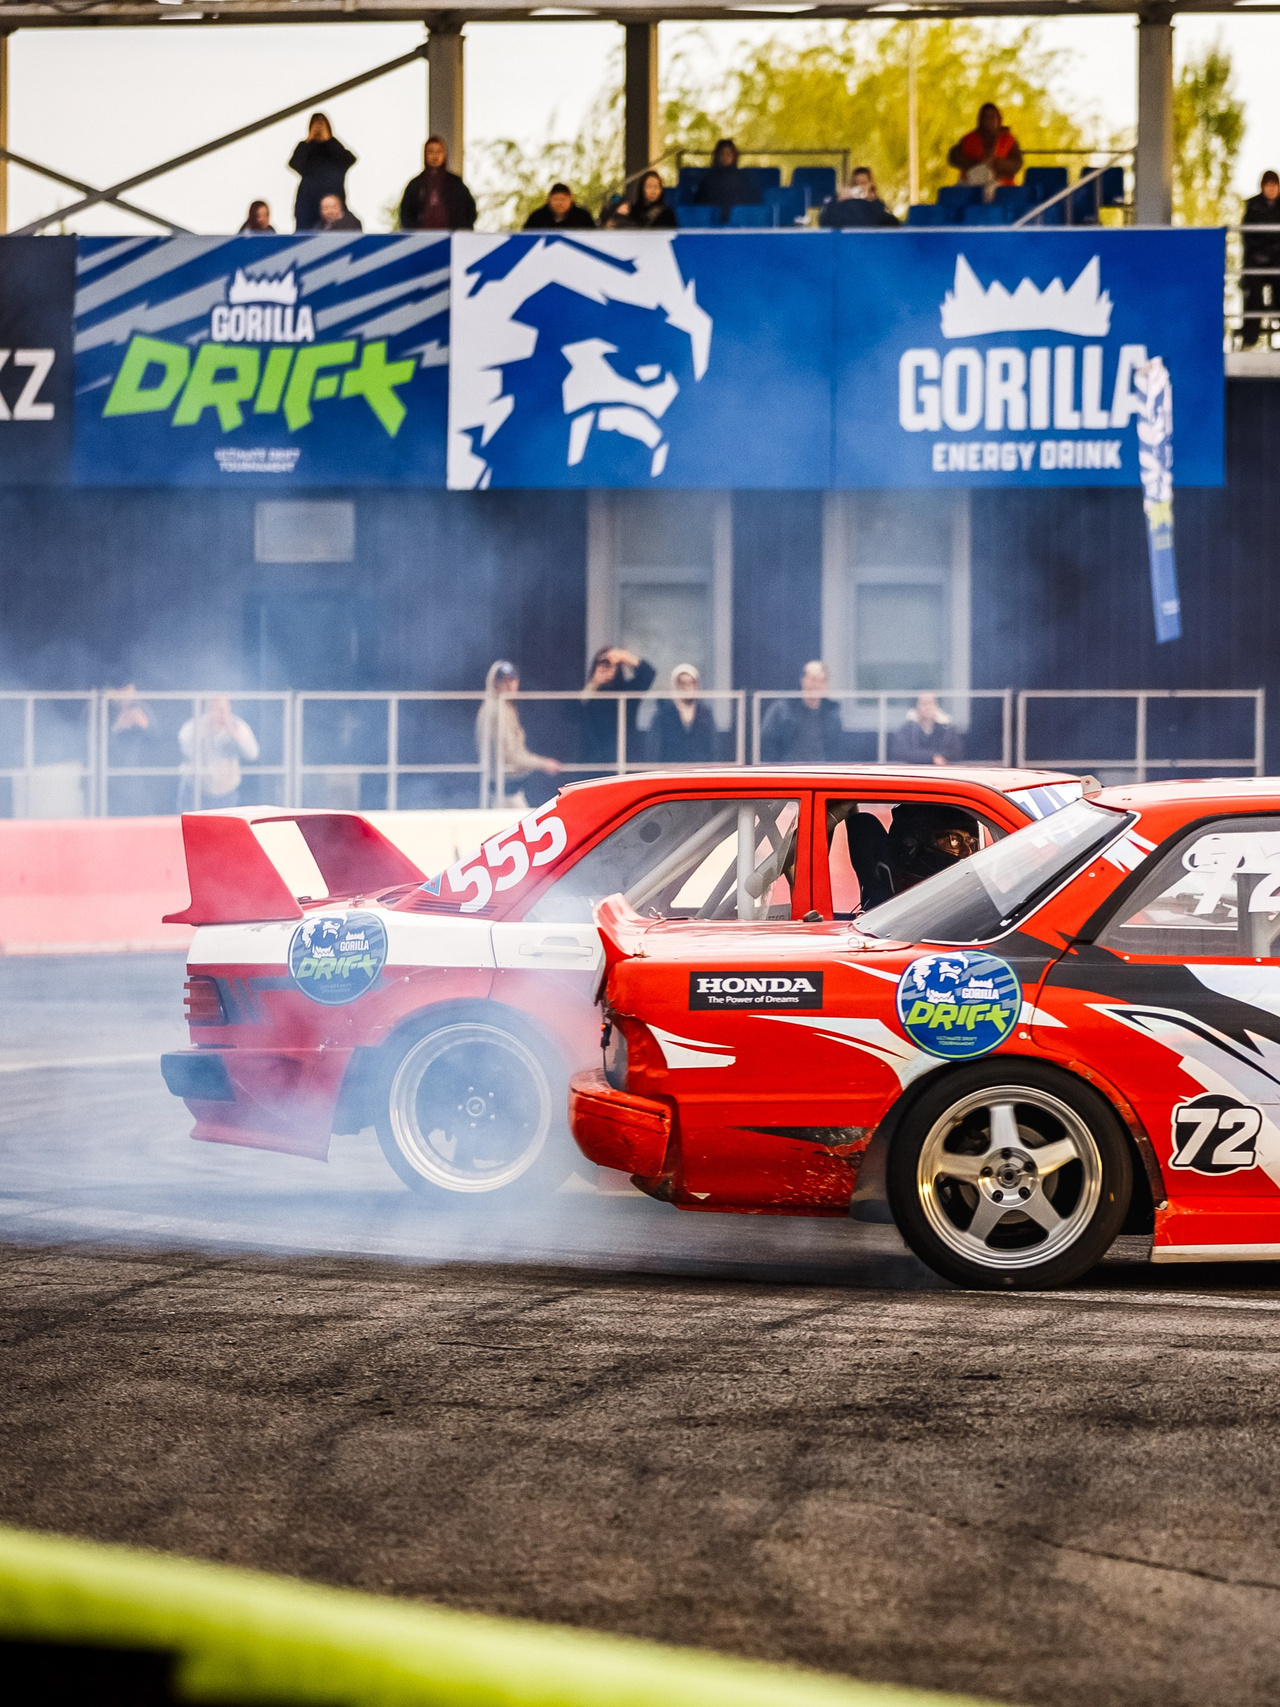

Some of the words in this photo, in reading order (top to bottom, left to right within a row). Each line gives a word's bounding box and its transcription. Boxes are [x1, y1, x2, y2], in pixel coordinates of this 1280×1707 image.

[211, 305, 315, 342] GORILLA
[0, 348, 55, 420] Z
[103, 335, 417, 438] DRIFT
[932, 442, 1036, 472] ENERGY
[1040, 440, 1122, 470] DRINK
[446, 800, 567, 913] 555
[340, 940, 369, 952] GORILLA
[295, 953, 378, 981] DRIFT
[696, 978, 816, 993] HONDA
[725, 996, 753, 1004] Power
[961, 988, 1000, 1000] GORILLA
[905, 1000, 1010, 1034] DRIFT
[1174, 1108, 1261, 1165] 72
